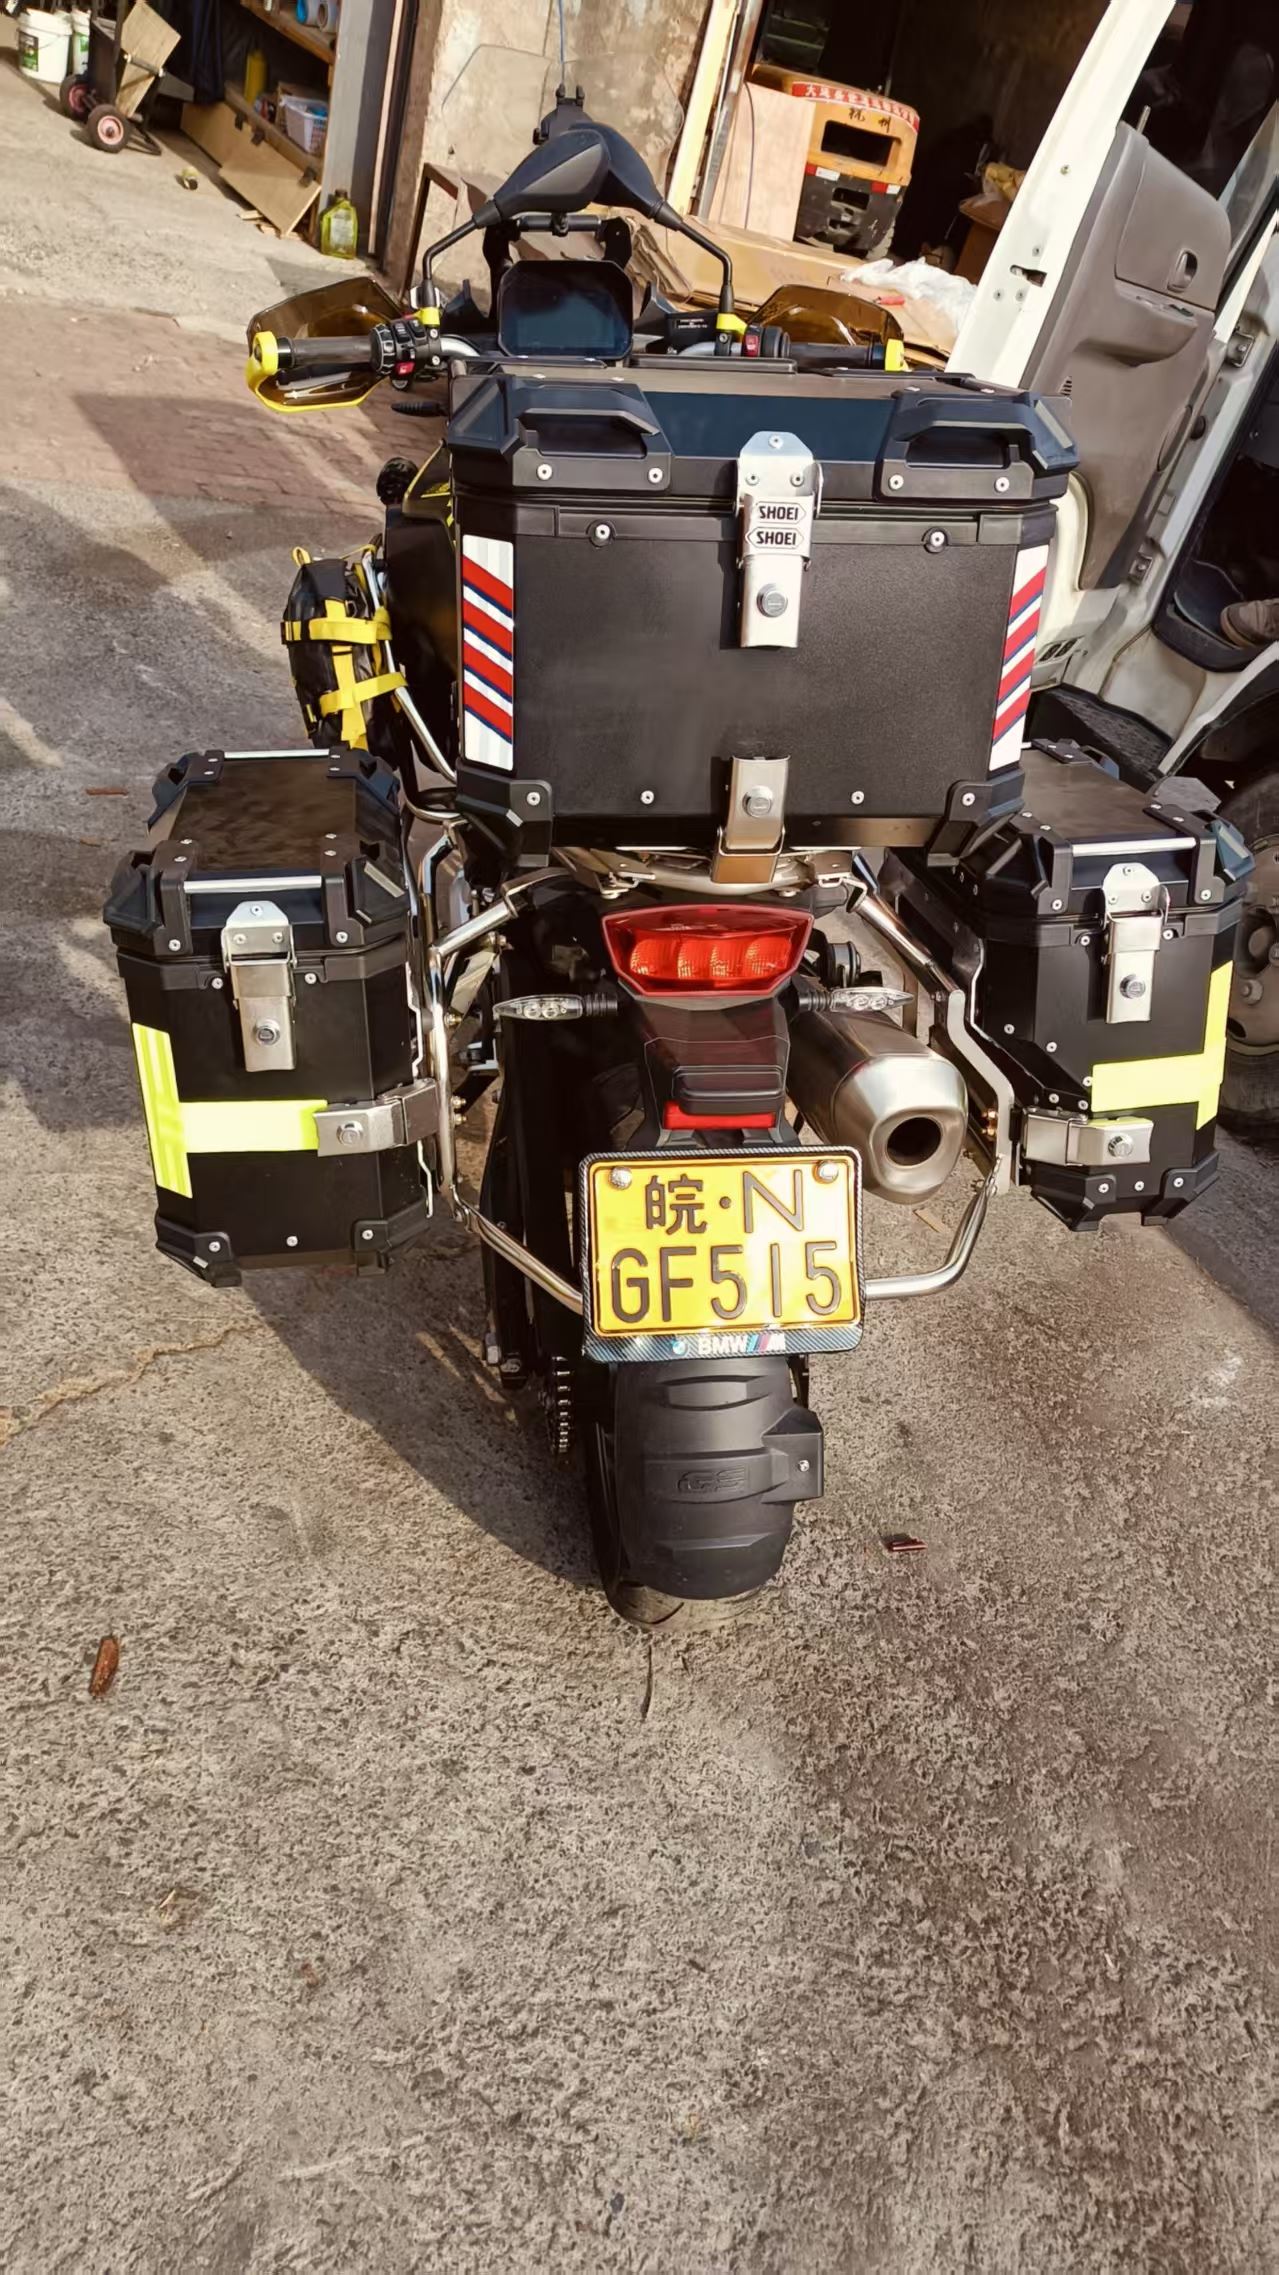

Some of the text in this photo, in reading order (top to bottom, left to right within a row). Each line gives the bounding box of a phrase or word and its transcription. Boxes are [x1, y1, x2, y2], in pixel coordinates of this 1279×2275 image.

[759, 506, 799, 521] SHOEI
[756, 531, 797, 546] SHOEI
[611, 1241, 841, 1323] GF515
[698, 1335, 748, 1355] BMW
[677, 1468, 746, 1493] GS
